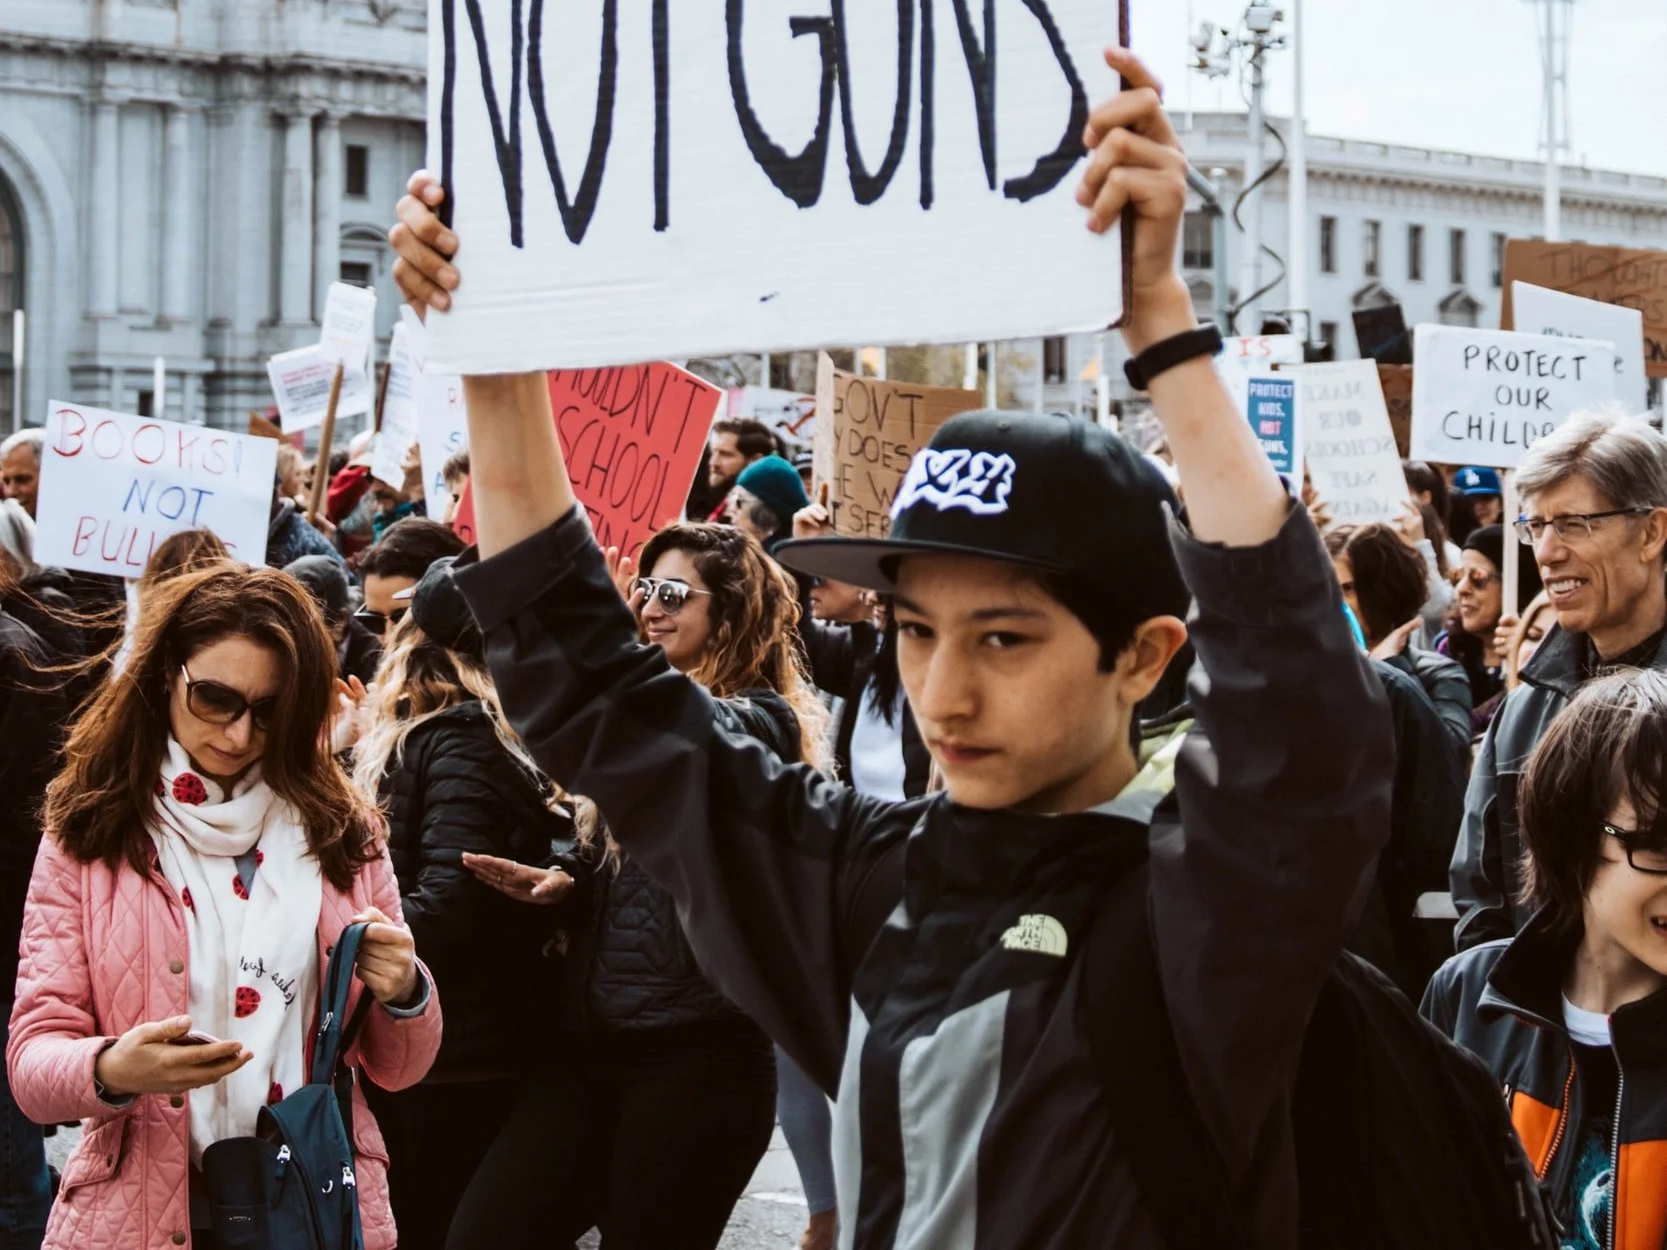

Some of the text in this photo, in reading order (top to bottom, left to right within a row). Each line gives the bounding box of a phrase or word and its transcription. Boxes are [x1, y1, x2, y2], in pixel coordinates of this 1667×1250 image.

[1463, 344, 1587, 381] PROTECT
[1249, 382, 1293, 399] PROTECT
[1495, 384, 1553, 411] OUR
[558, 406, 672, 532] SCHOOL
[122, 477, 215, 527] NOT
